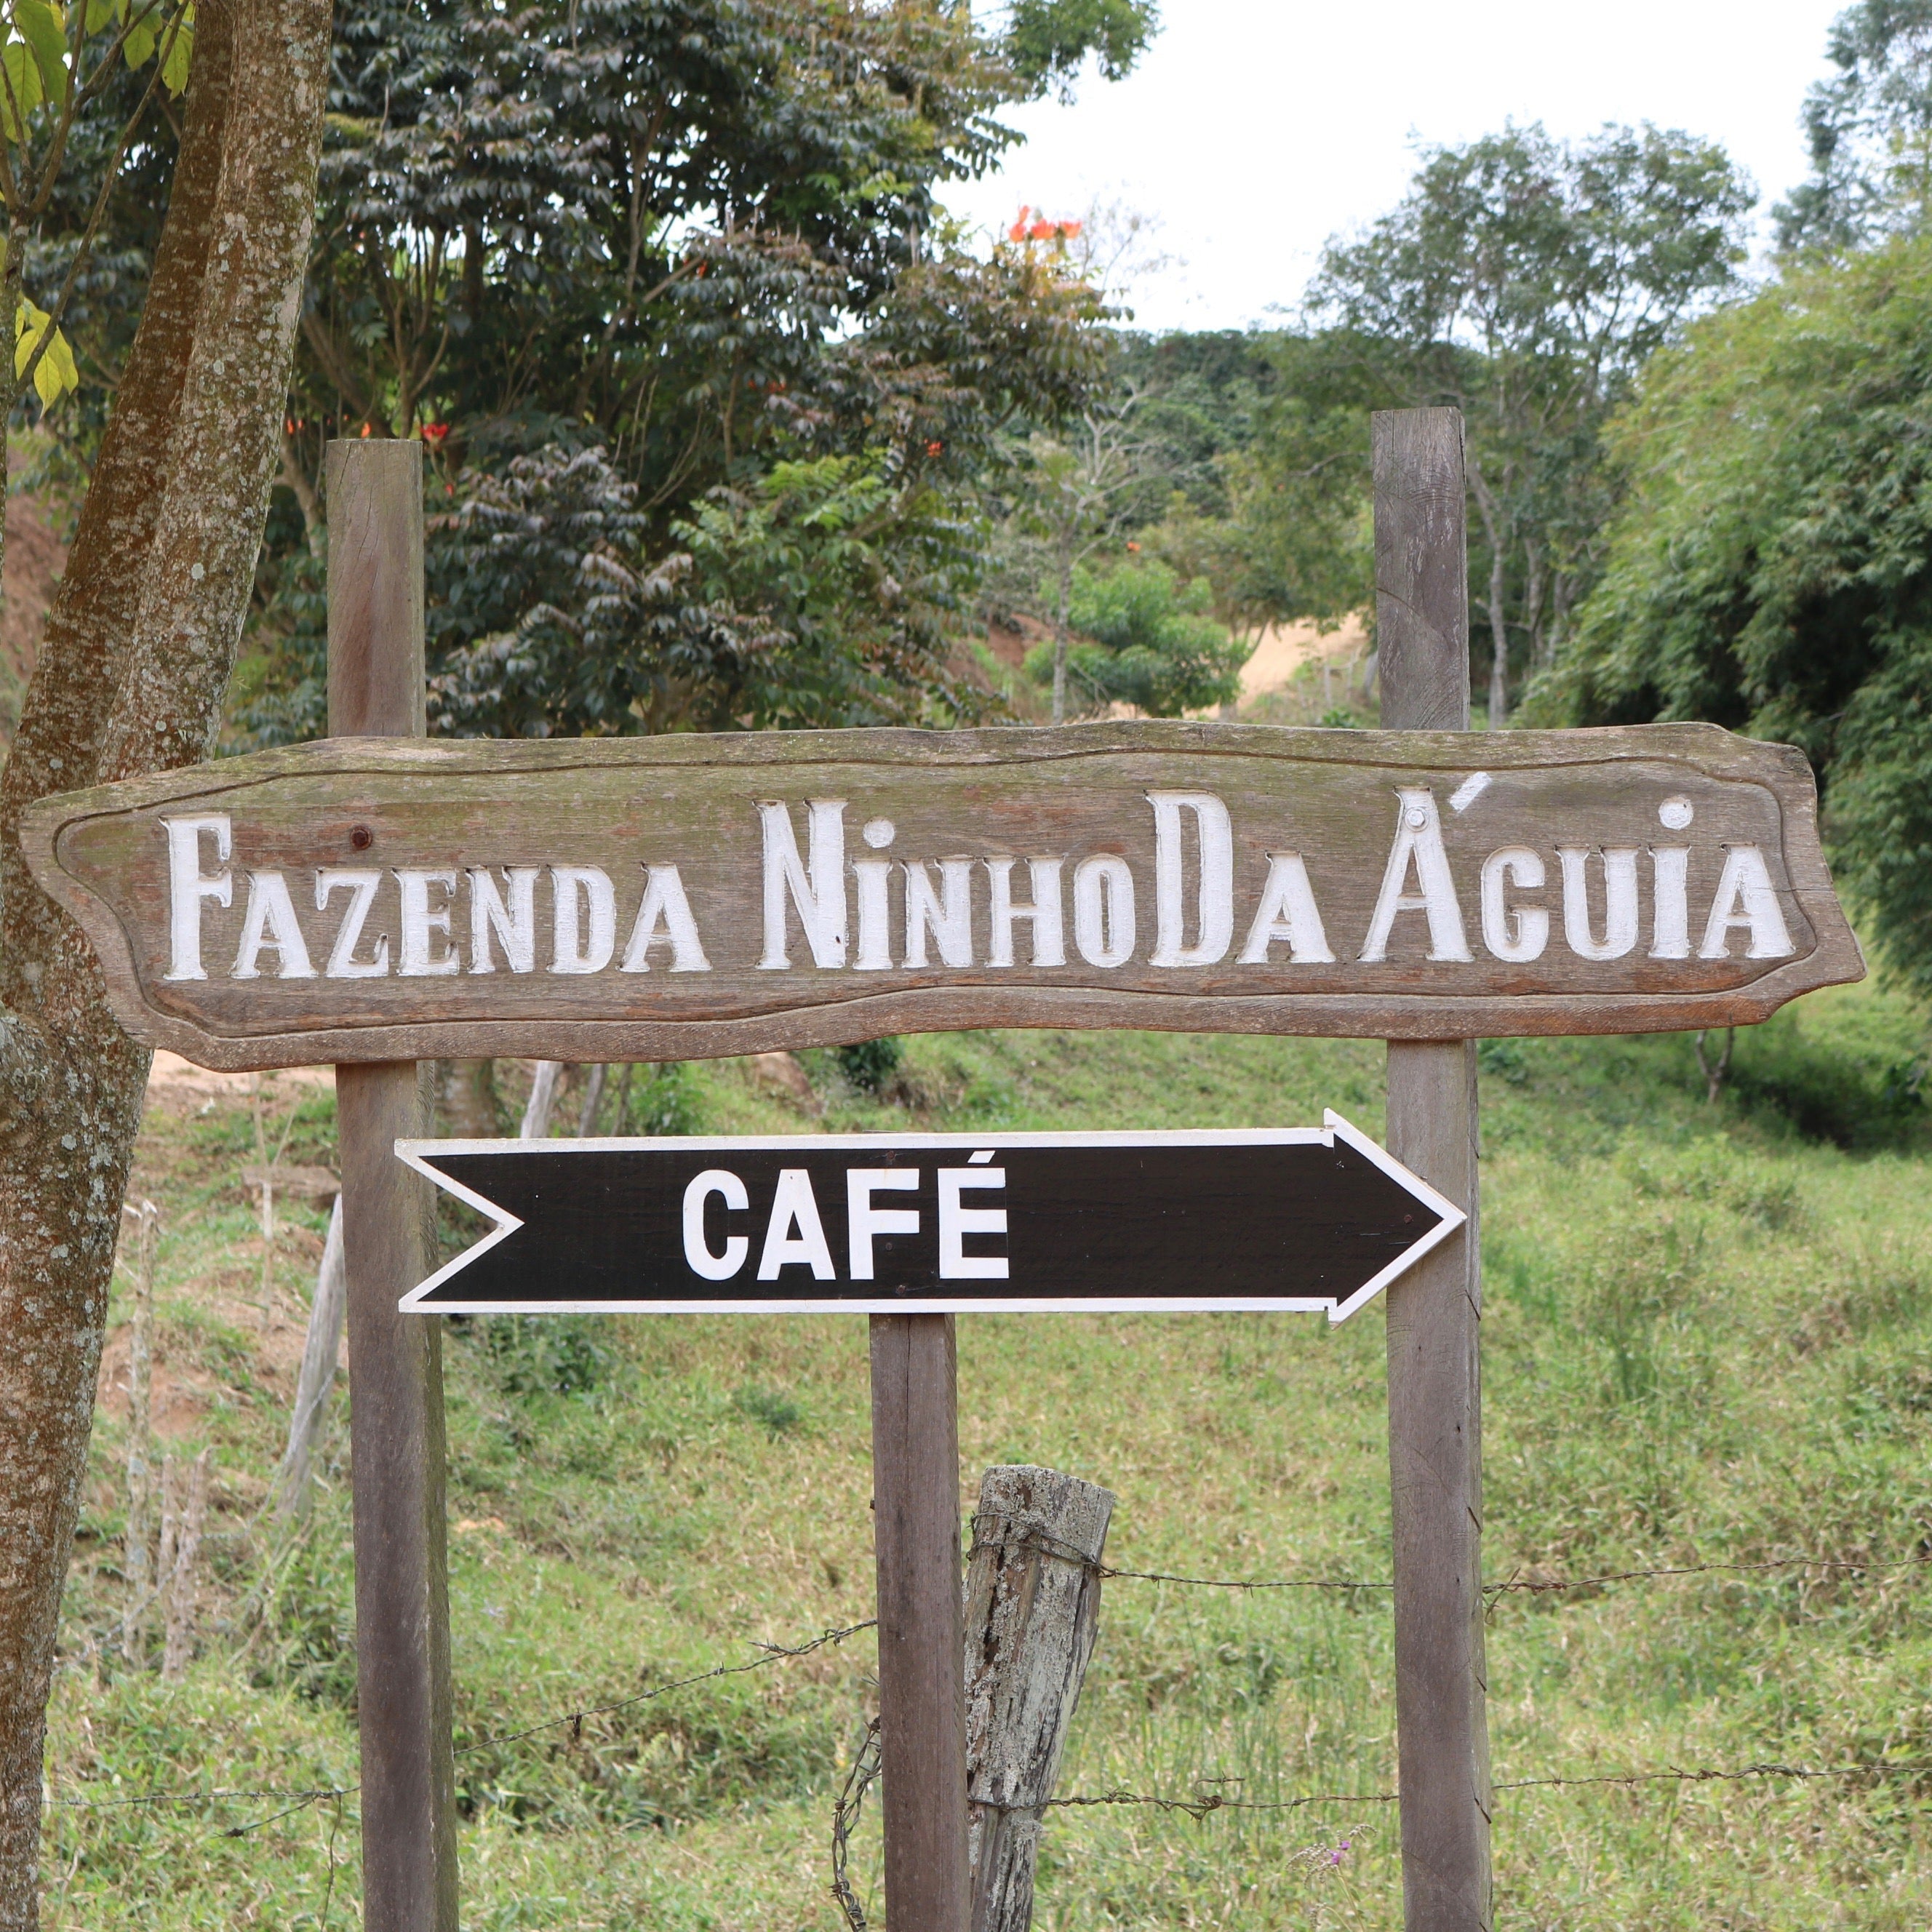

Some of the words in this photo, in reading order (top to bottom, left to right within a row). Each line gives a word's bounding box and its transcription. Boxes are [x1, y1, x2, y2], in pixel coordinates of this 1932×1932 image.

[158, 812, 714, 981] FAZENDA
[1143, 789, 1337, 970] DA
[682, 1149, 1010, 1281] CAFÉ
